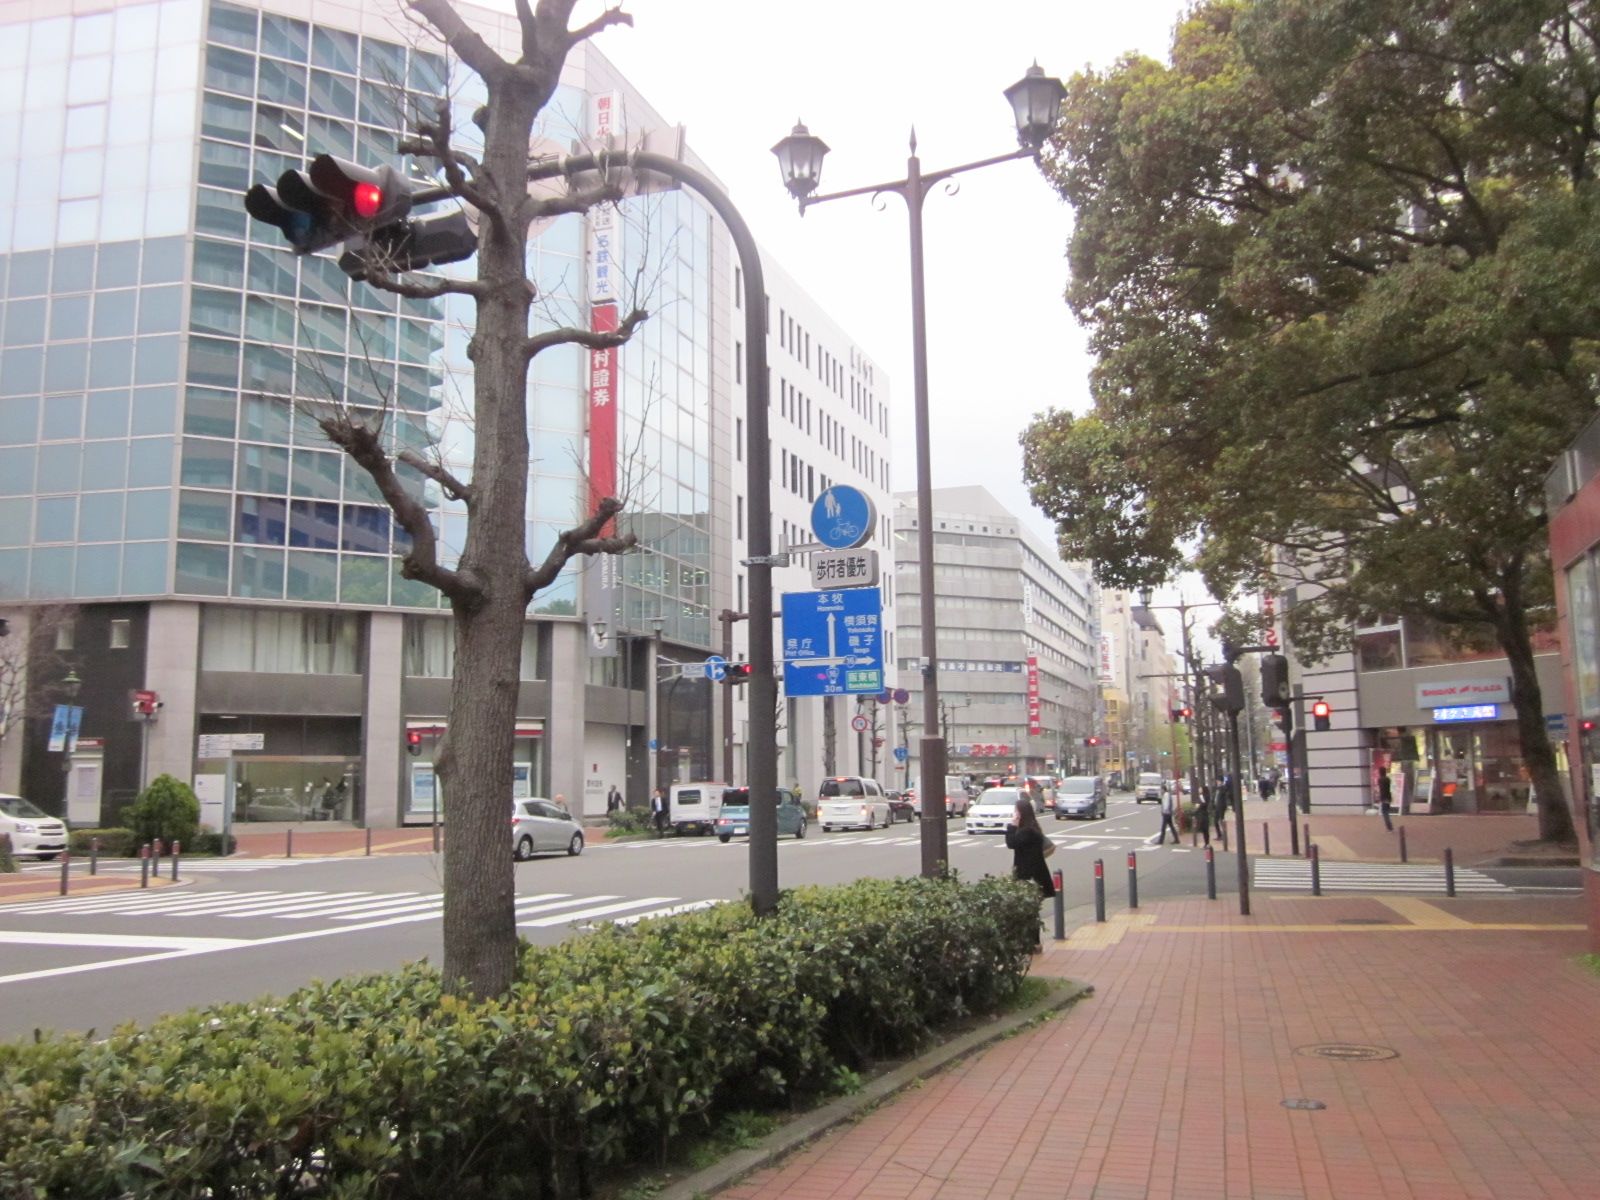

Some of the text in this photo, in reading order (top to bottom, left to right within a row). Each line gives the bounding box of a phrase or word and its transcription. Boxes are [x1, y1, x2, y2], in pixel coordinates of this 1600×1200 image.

[596, 235, 608, 294] 名鉄観光
[593, 331, 610, 407] 村證券
[816, 556, 866, 580] 歩行者優先
[818, 594, 844, 604] 本牧
[844, 615, 877, 626] 横須賀
[787, 638, 812, 650] 県庁
[848, 635, 875, 646] 磯子
